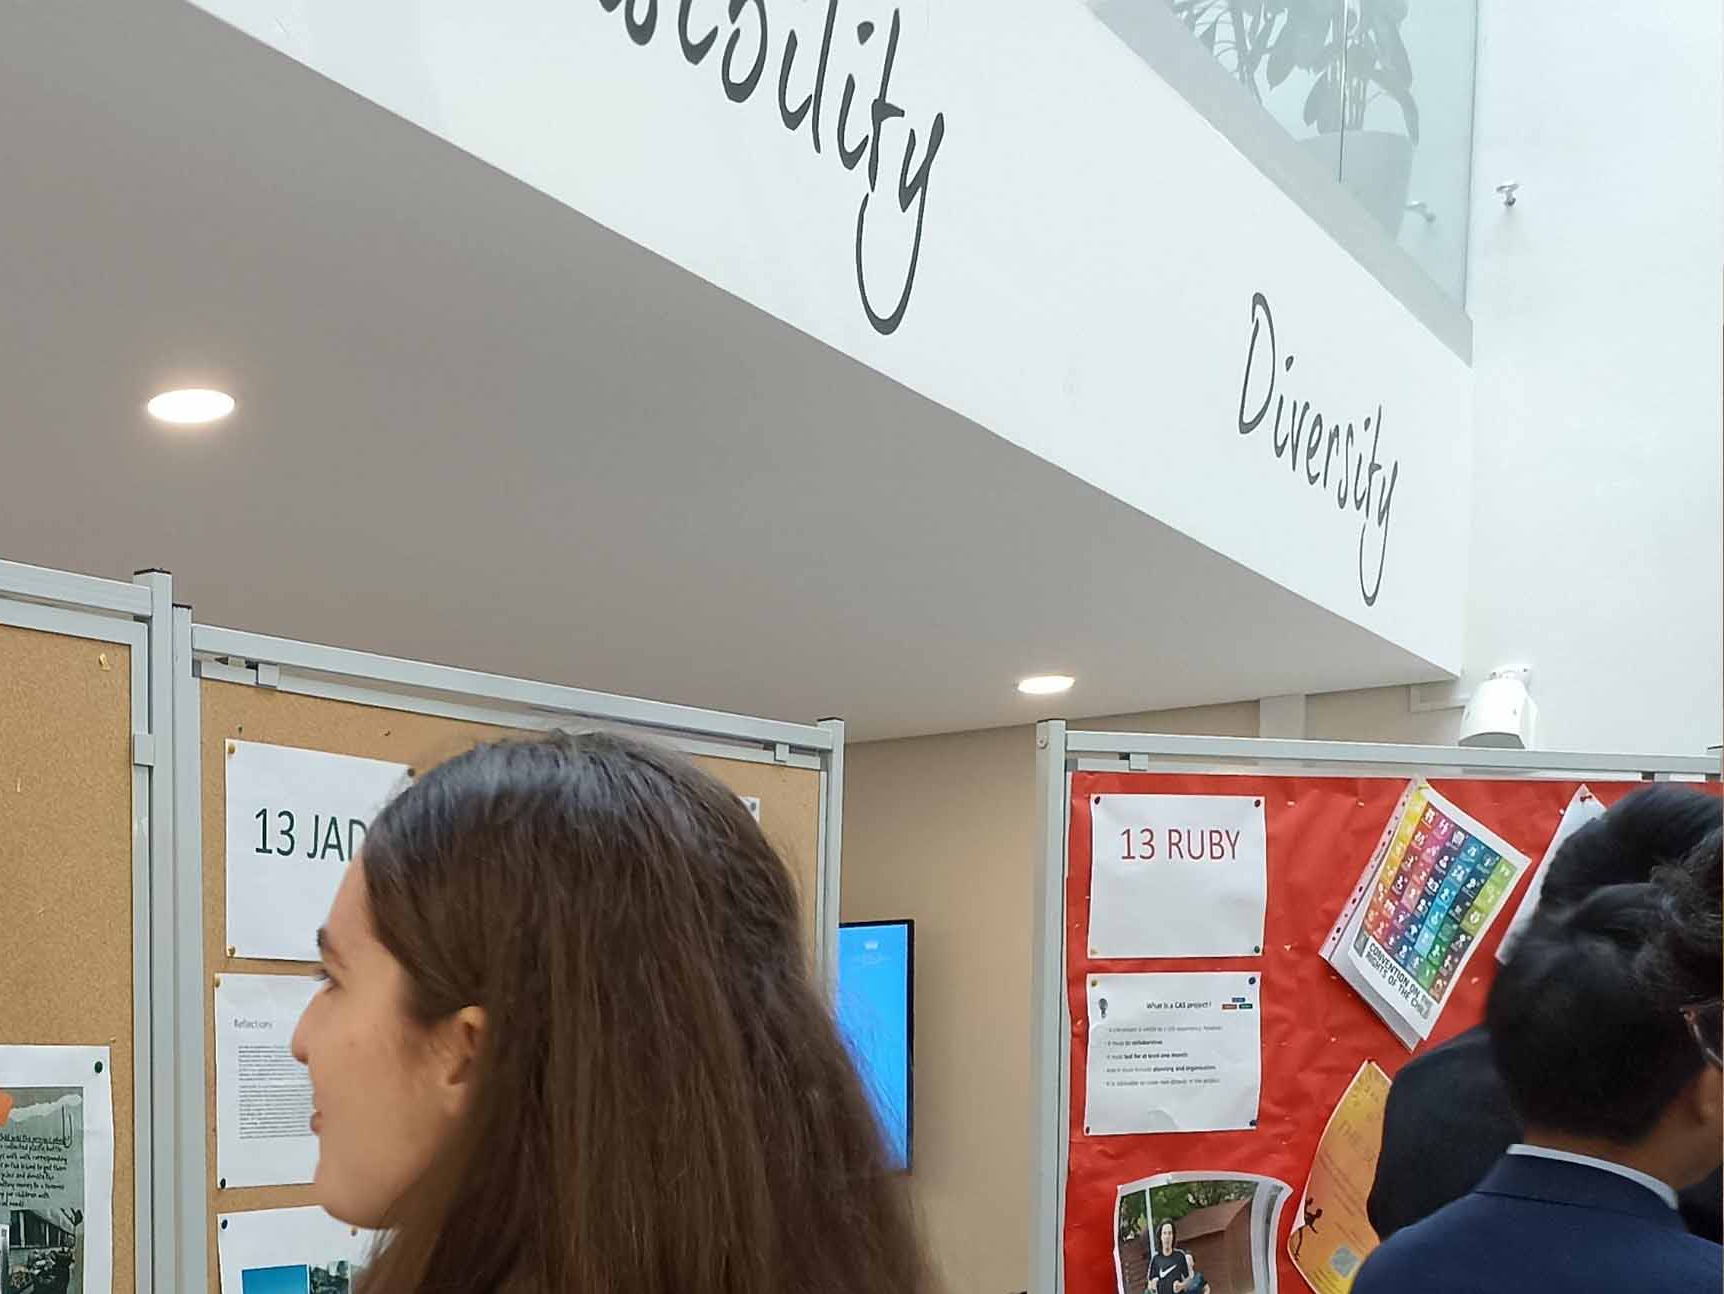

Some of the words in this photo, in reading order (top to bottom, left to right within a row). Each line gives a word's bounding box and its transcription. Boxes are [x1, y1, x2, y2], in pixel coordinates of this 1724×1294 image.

[1238, 292, 1398, 607] Diversity
[255, 808, 295, 856] 13
[307, 814, 367, 861] JAD
[1121, 828, 1155, 860] 13
[1168, 828, 1240, 860] RUBY
[1175, 1001, 1186, 1009] CAS
